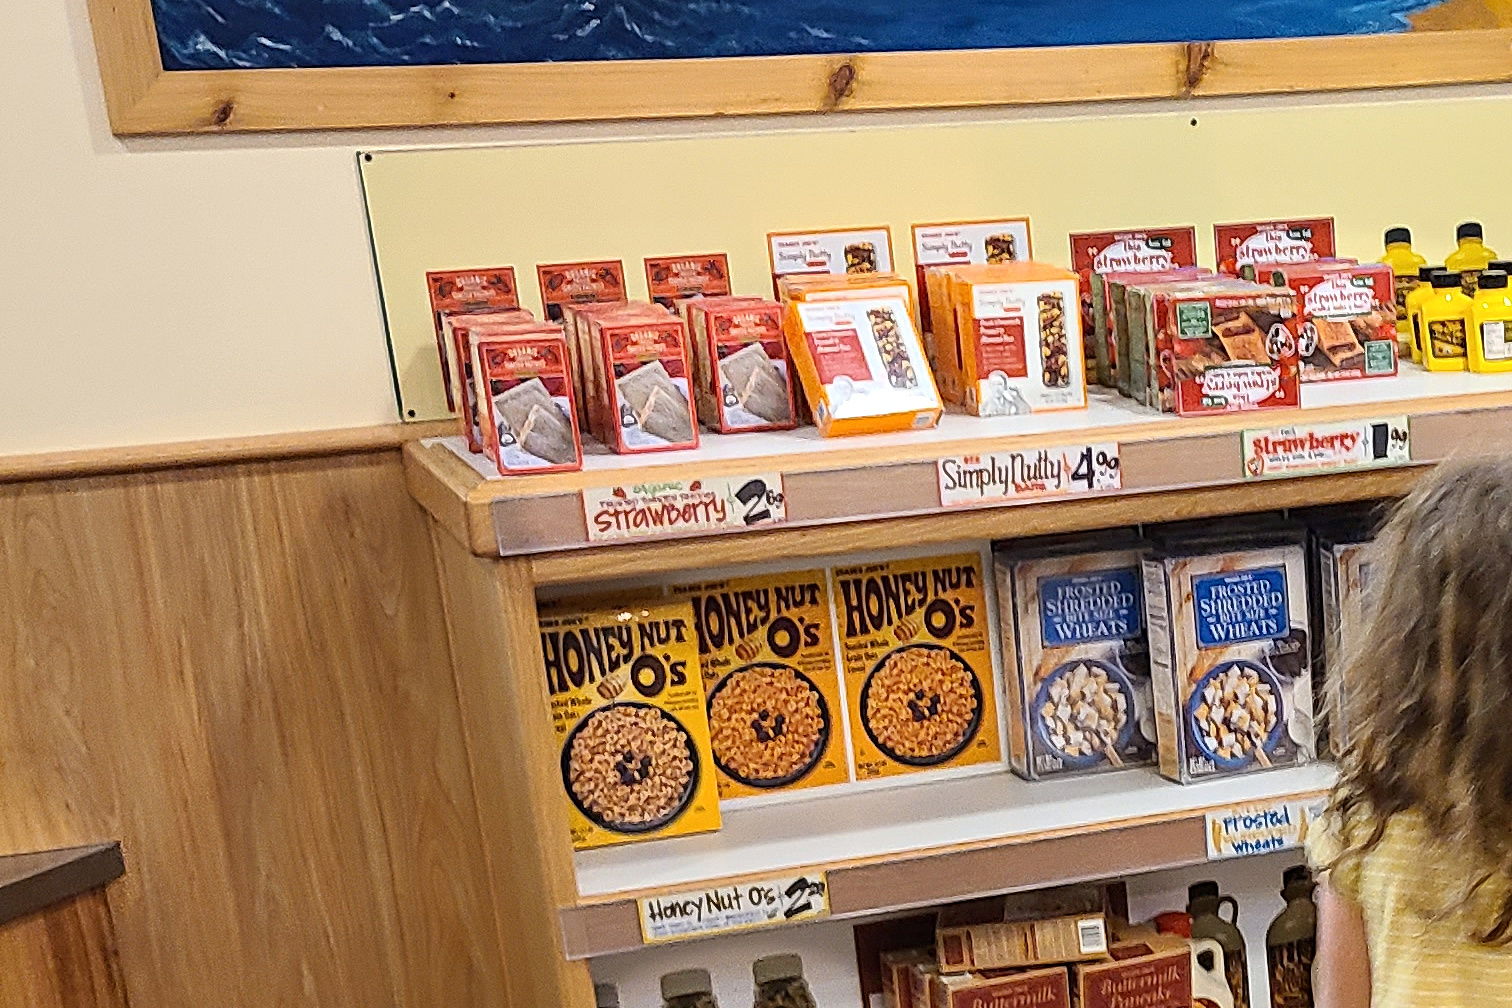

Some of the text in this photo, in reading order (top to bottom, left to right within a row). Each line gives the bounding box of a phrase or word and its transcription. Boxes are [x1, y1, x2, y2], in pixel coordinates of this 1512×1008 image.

[942, 455, 1009, 497] Simply
[1010, 449, 1062, 490] Nutty
[774, 583, 821, 615] NUT
[839, 565, 976, 638] HONEY NUT
[1057, 581, 1121, 600] FROSTED
[1209, 579, 1271, 600] FROSTED
[1045, 592, 1134, 616] SHREDDED
[1199, 591, 1283, 615] SHREDDED
[1055, 620, 1128, 640] WHEATS
[1209, 618, 1278, 641] WHEATS
[540, 619, 688, 696] HONEY NUT
[648, 896, 702, 923] Honey
[705, 885, 744, 914] Nut
